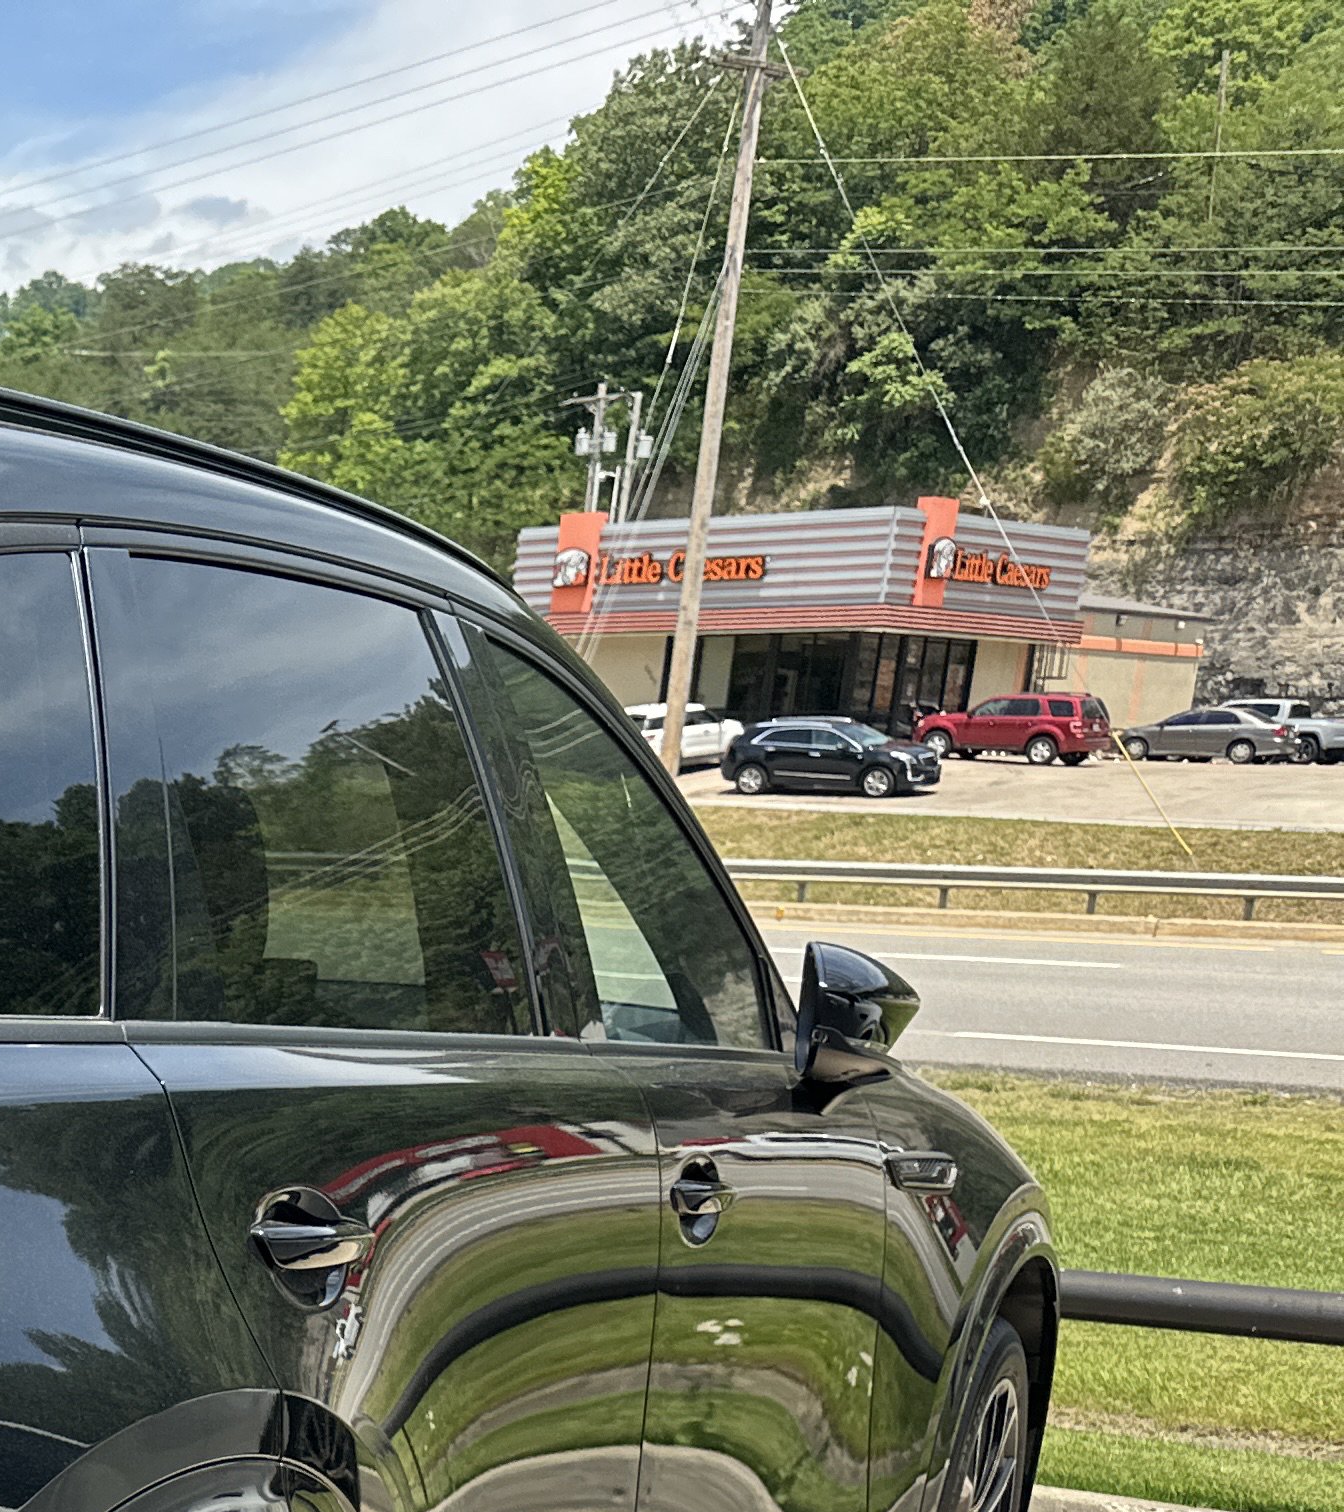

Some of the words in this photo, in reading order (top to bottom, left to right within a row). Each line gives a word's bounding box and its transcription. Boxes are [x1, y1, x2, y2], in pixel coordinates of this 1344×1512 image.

[599, 551, 662, 585] Little
[667, 551, 764, 583] Cesars
[953, 548, 994, 583] Little
[996, 552, 1051, 590] Caesars
